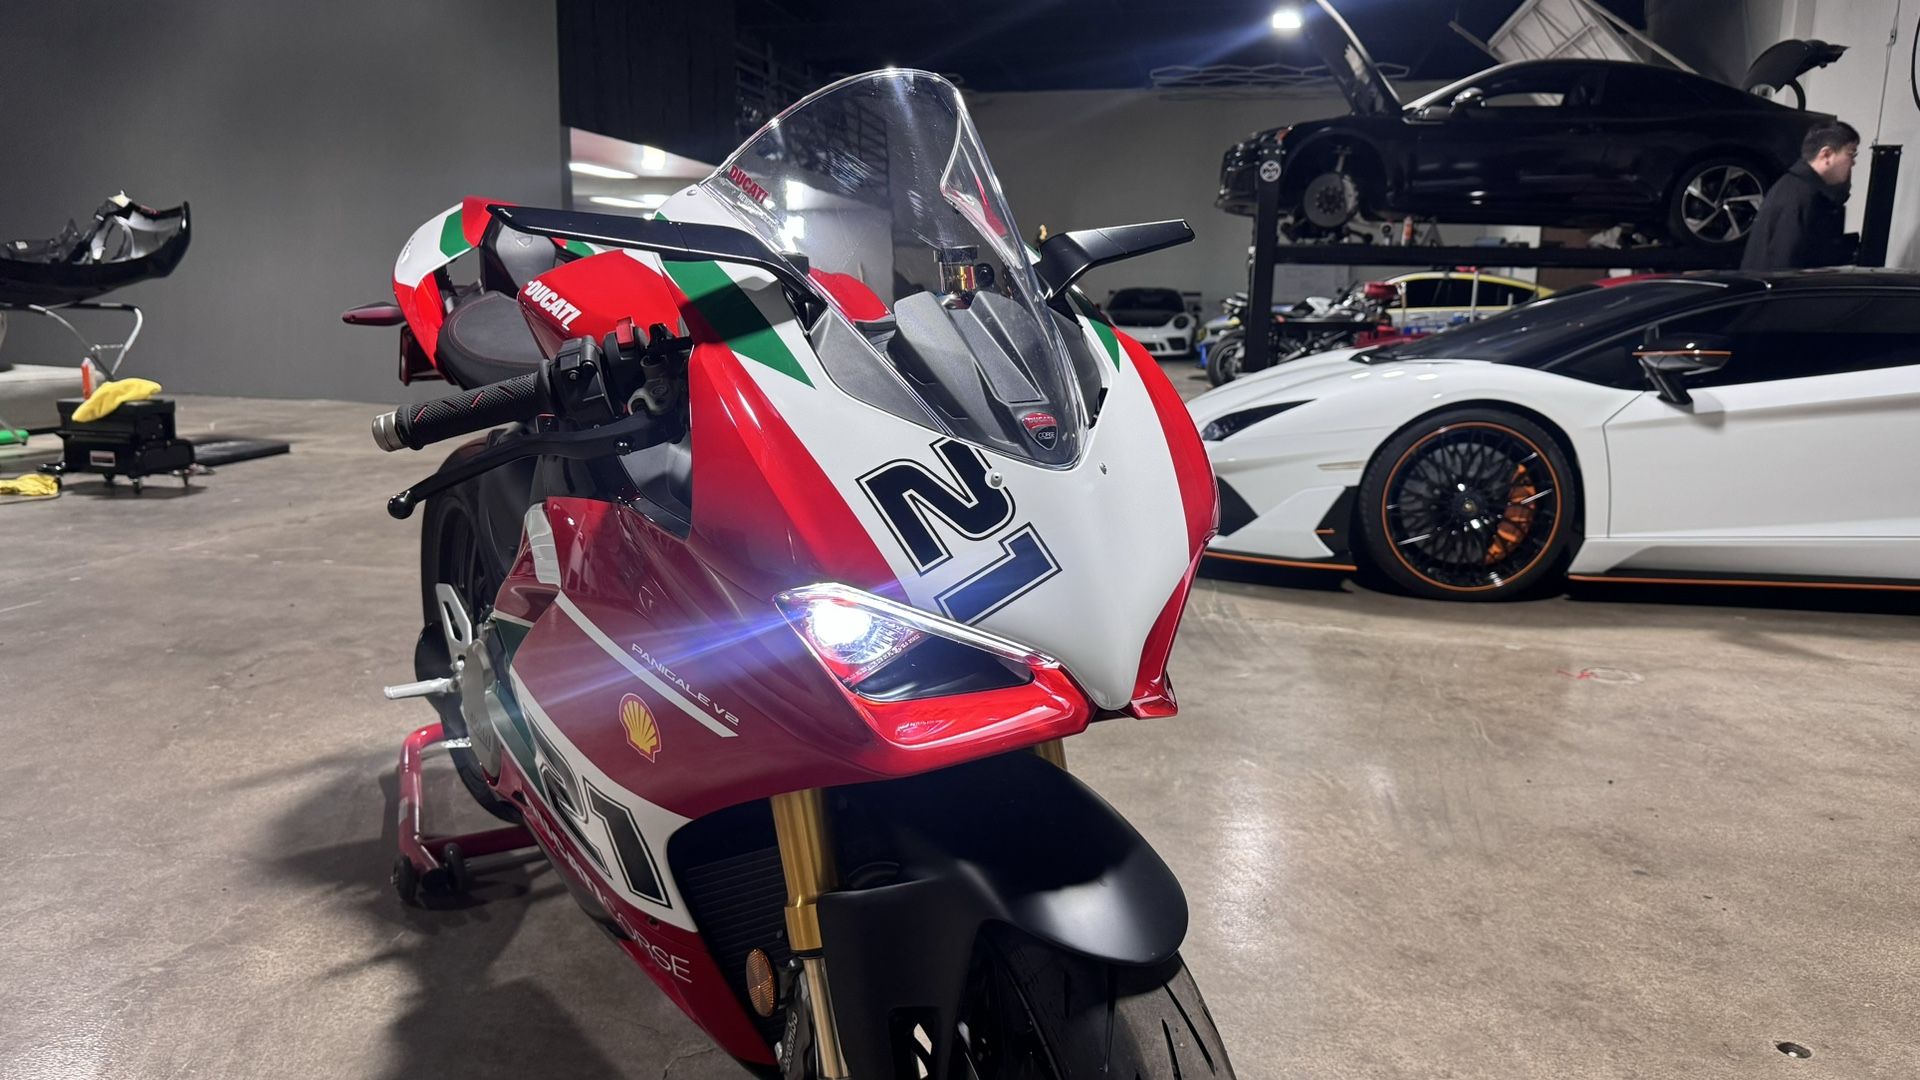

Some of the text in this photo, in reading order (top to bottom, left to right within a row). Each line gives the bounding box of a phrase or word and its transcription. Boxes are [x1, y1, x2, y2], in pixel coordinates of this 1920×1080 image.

[729, 164, 769, 205] DUCATI
[524, 280, 582, 331] DUCATI
[855, 437, 1063, 626] 21
[631, 643, 739, 726] PANIGALE V2
[523, 702, 672, 910] 21
[603, 895, 692, 983] CORSE
